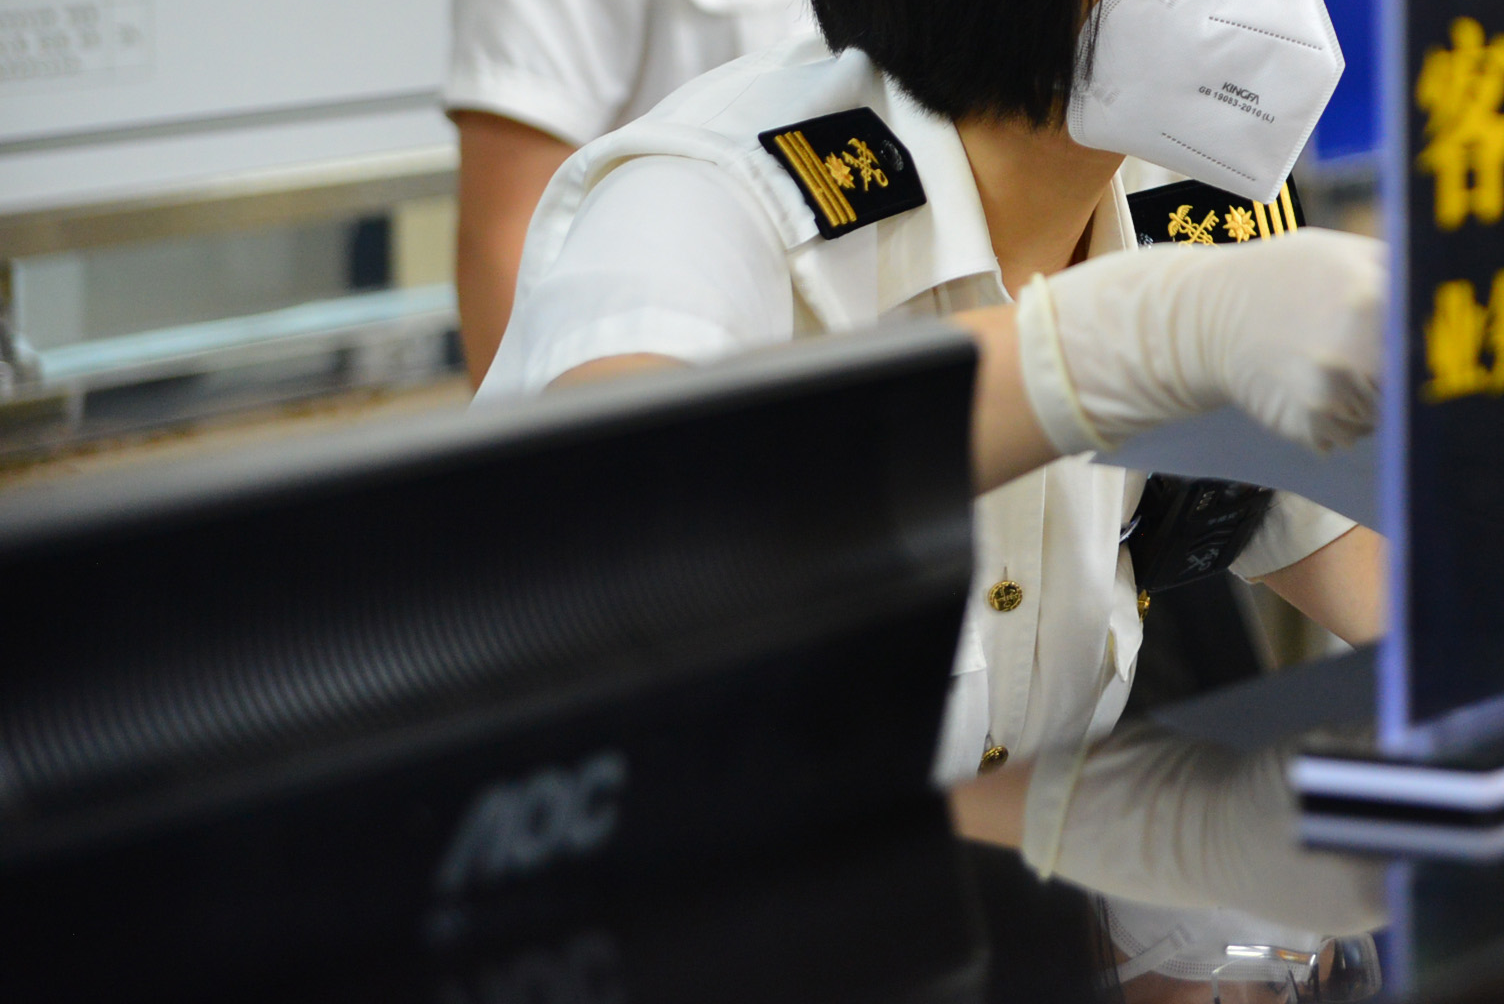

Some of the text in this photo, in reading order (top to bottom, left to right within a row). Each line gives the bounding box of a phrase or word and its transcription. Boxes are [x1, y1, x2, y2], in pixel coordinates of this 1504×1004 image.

[1198, 85, 1212, 96] GB
[1222, 82, 1260, 105] KINGFA
[436, 751, 628, 892] AOC
